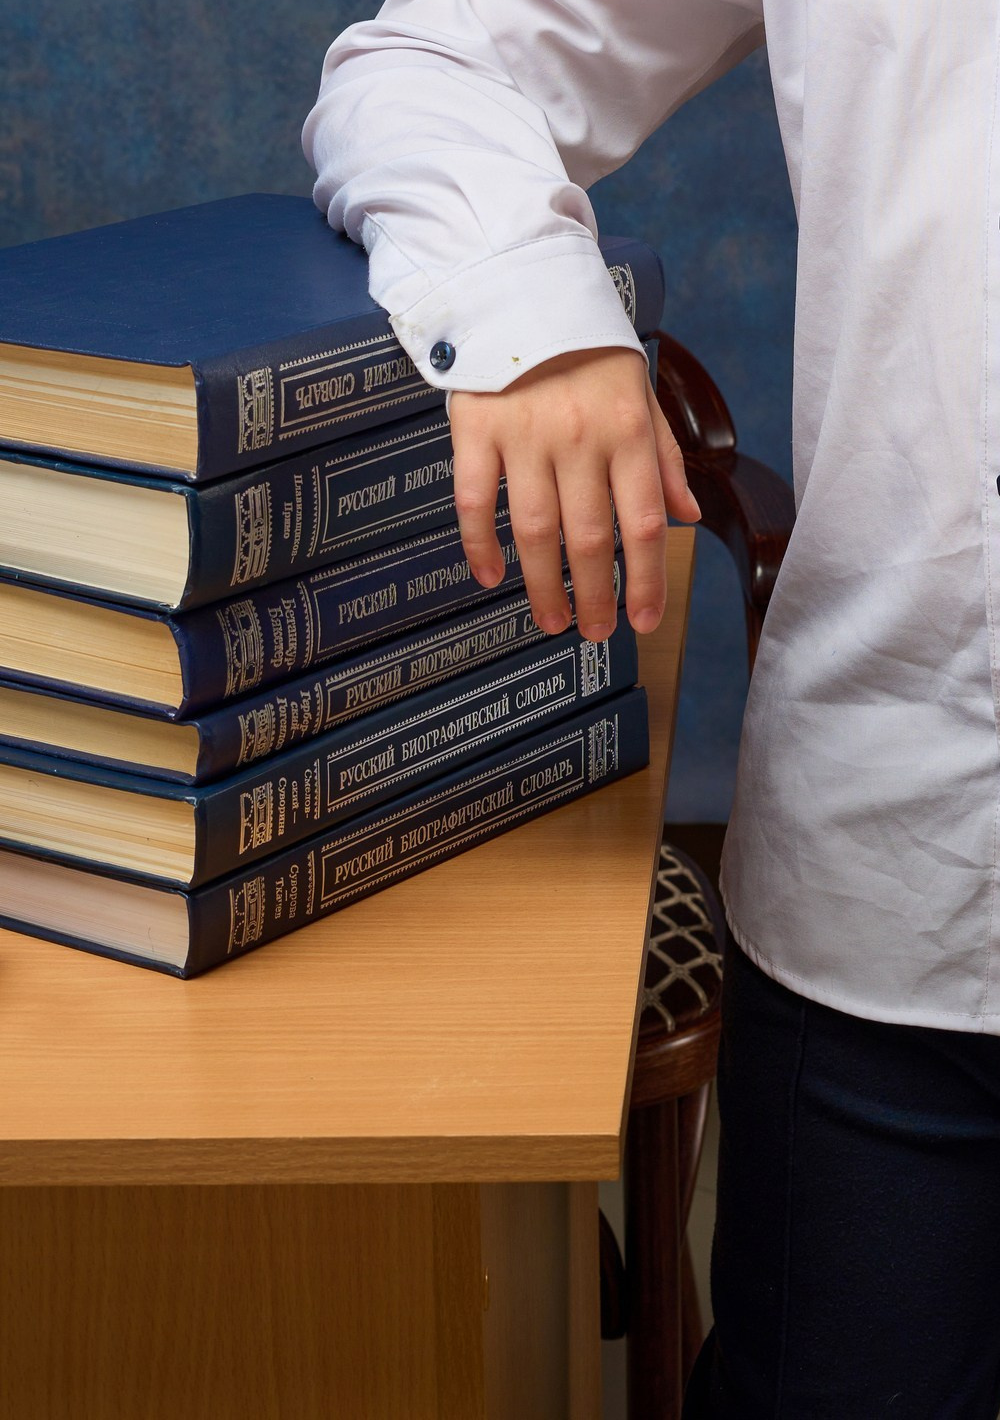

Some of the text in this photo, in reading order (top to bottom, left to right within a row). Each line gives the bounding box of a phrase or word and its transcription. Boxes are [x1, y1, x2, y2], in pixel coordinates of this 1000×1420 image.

[296, 372, 355, 410] СЛОВАРЬ
[283, 501, 293, 539] Примо
[337, 475, 397, 517] РУССКИЙ
[338, 582, 398, 625] РУССКИЙ
[346, 666, 402, 710] РУССКИЙ
[409, 616, 518, 682] БИОГРАФИЧЕСКИЙ
[339, 674, 567, 791] РУССКИЙ БИОГРАФИЧЕСКИЙ СЛОВАРЬ
[277, 776, 288, 836] Суворина
[303, 768, 313, 819] Смелов-
[335, 759, 574, 886] РУССКИЙ БИОГРАФИЧЕСКИЙ СЛОВАРЬ
[274, 876, 285, 919] Ткачев
[288, 864, 299, 919] Суворова
